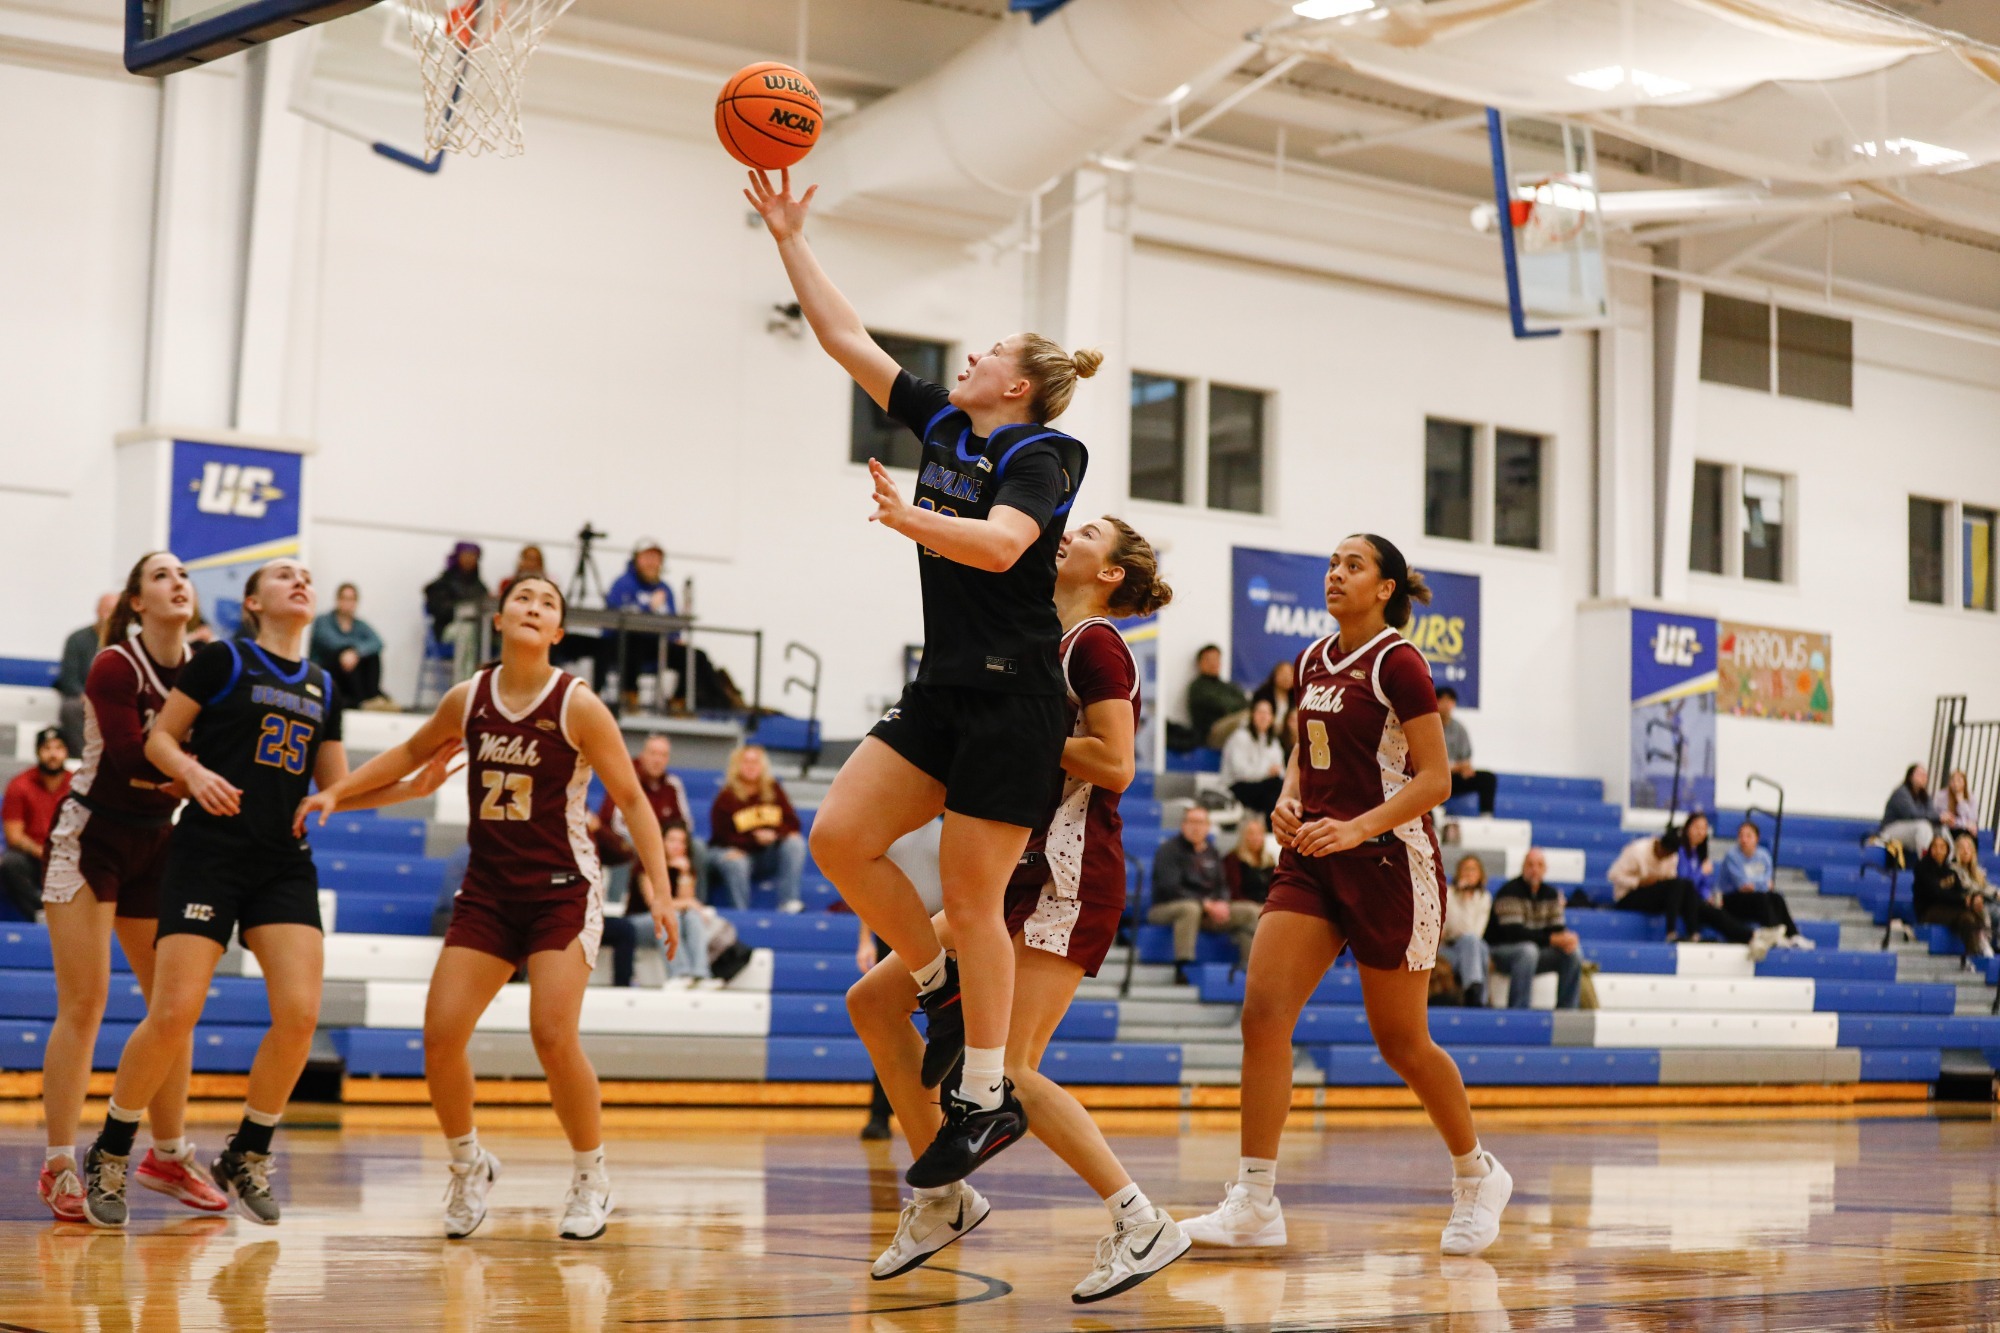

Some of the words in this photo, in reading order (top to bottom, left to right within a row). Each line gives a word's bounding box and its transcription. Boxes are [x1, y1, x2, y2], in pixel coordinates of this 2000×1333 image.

[768, 108, 816, 135] NCAA
[197, 462, 274, 519] UC
[1399, 614, 1466, 655] URS
[1654, 623, 1698, 667] UC
[1299, 682, 1344, 713] Walsh
[255, 713, 315, 775] 25
[477, 732, 541, 767] Walsh
[1306, 719, 1331, 770] 8
[479, 770, 533, 821] 23
[184, 903, 213, 922] UC
